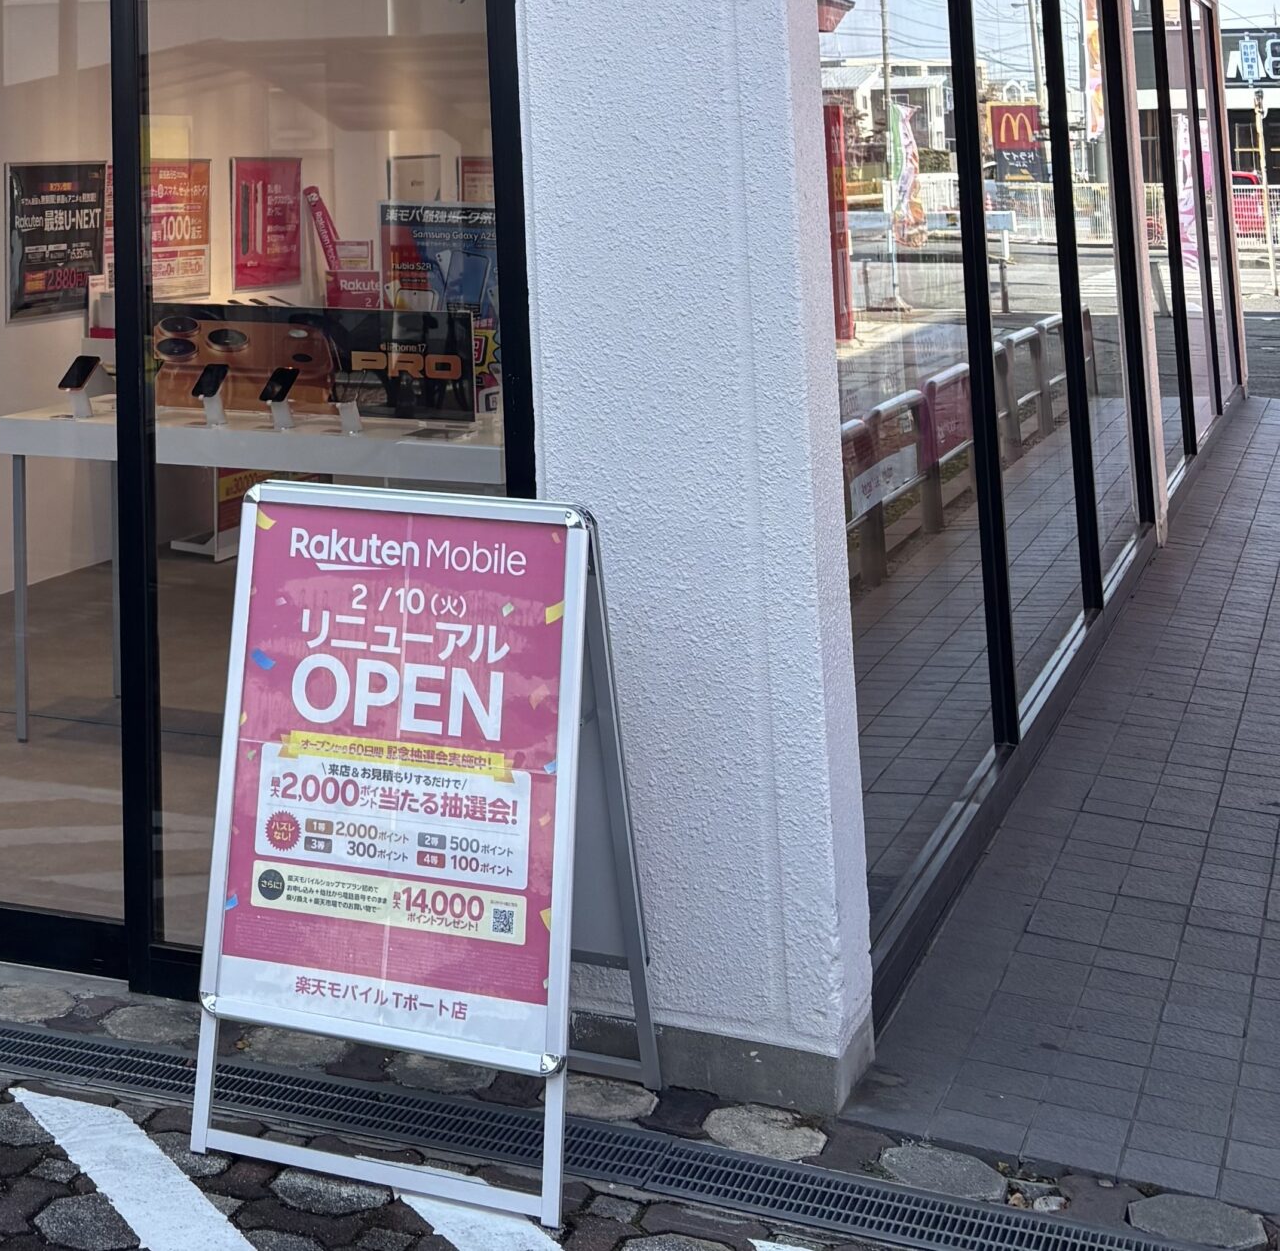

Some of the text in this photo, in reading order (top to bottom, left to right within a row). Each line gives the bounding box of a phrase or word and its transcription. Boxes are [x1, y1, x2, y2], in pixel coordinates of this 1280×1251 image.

[351, 351, 461, 380] PRO
[289, 527, 527, 576] Rakuten Mobile
[301, 609, 510, 663] リニューアル
[291, 653, 504, 741] OPEN
[271, 821, 295, 831] ハズレ
[273, 830, 292, 841] なし!
[260, 879, 283, 890] さらに!
[407, 912, 479, 932] ポイントプレゼント!
[295, 976, 468, 1022] 楽天モバイル Tポート店
